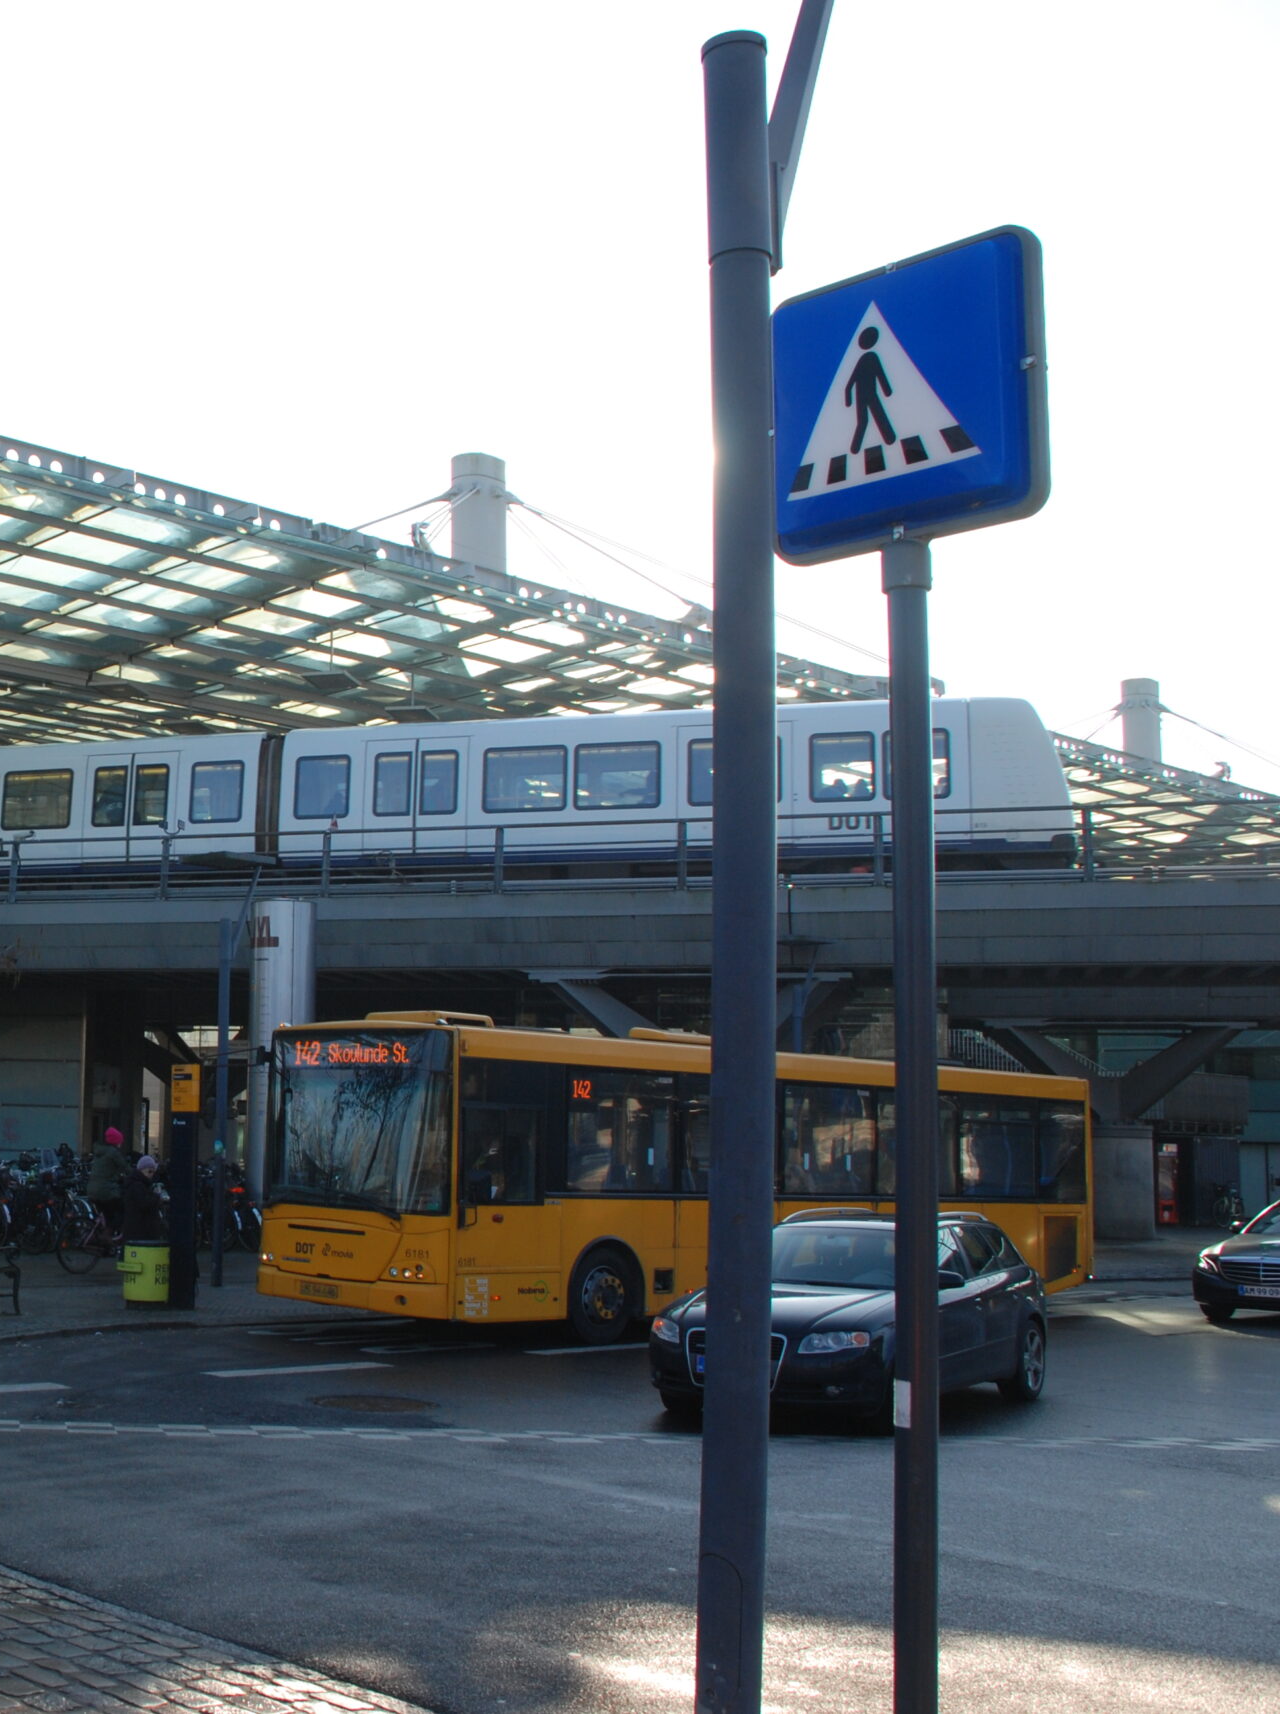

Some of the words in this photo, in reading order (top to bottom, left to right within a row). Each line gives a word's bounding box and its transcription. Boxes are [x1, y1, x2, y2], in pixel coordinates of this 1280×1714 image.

[294, 1040, 321, 1065] 142
[328, 1042, 389, 1064] Skovlunde
[392, 1042, 410, 1064] St.
[572, 1080, 592, 1099] 142
[295, 1241, 315, 1255] DOT
[405, 1248, 430, 1259] 6181
[155, 1264, 169, 1272] RE
